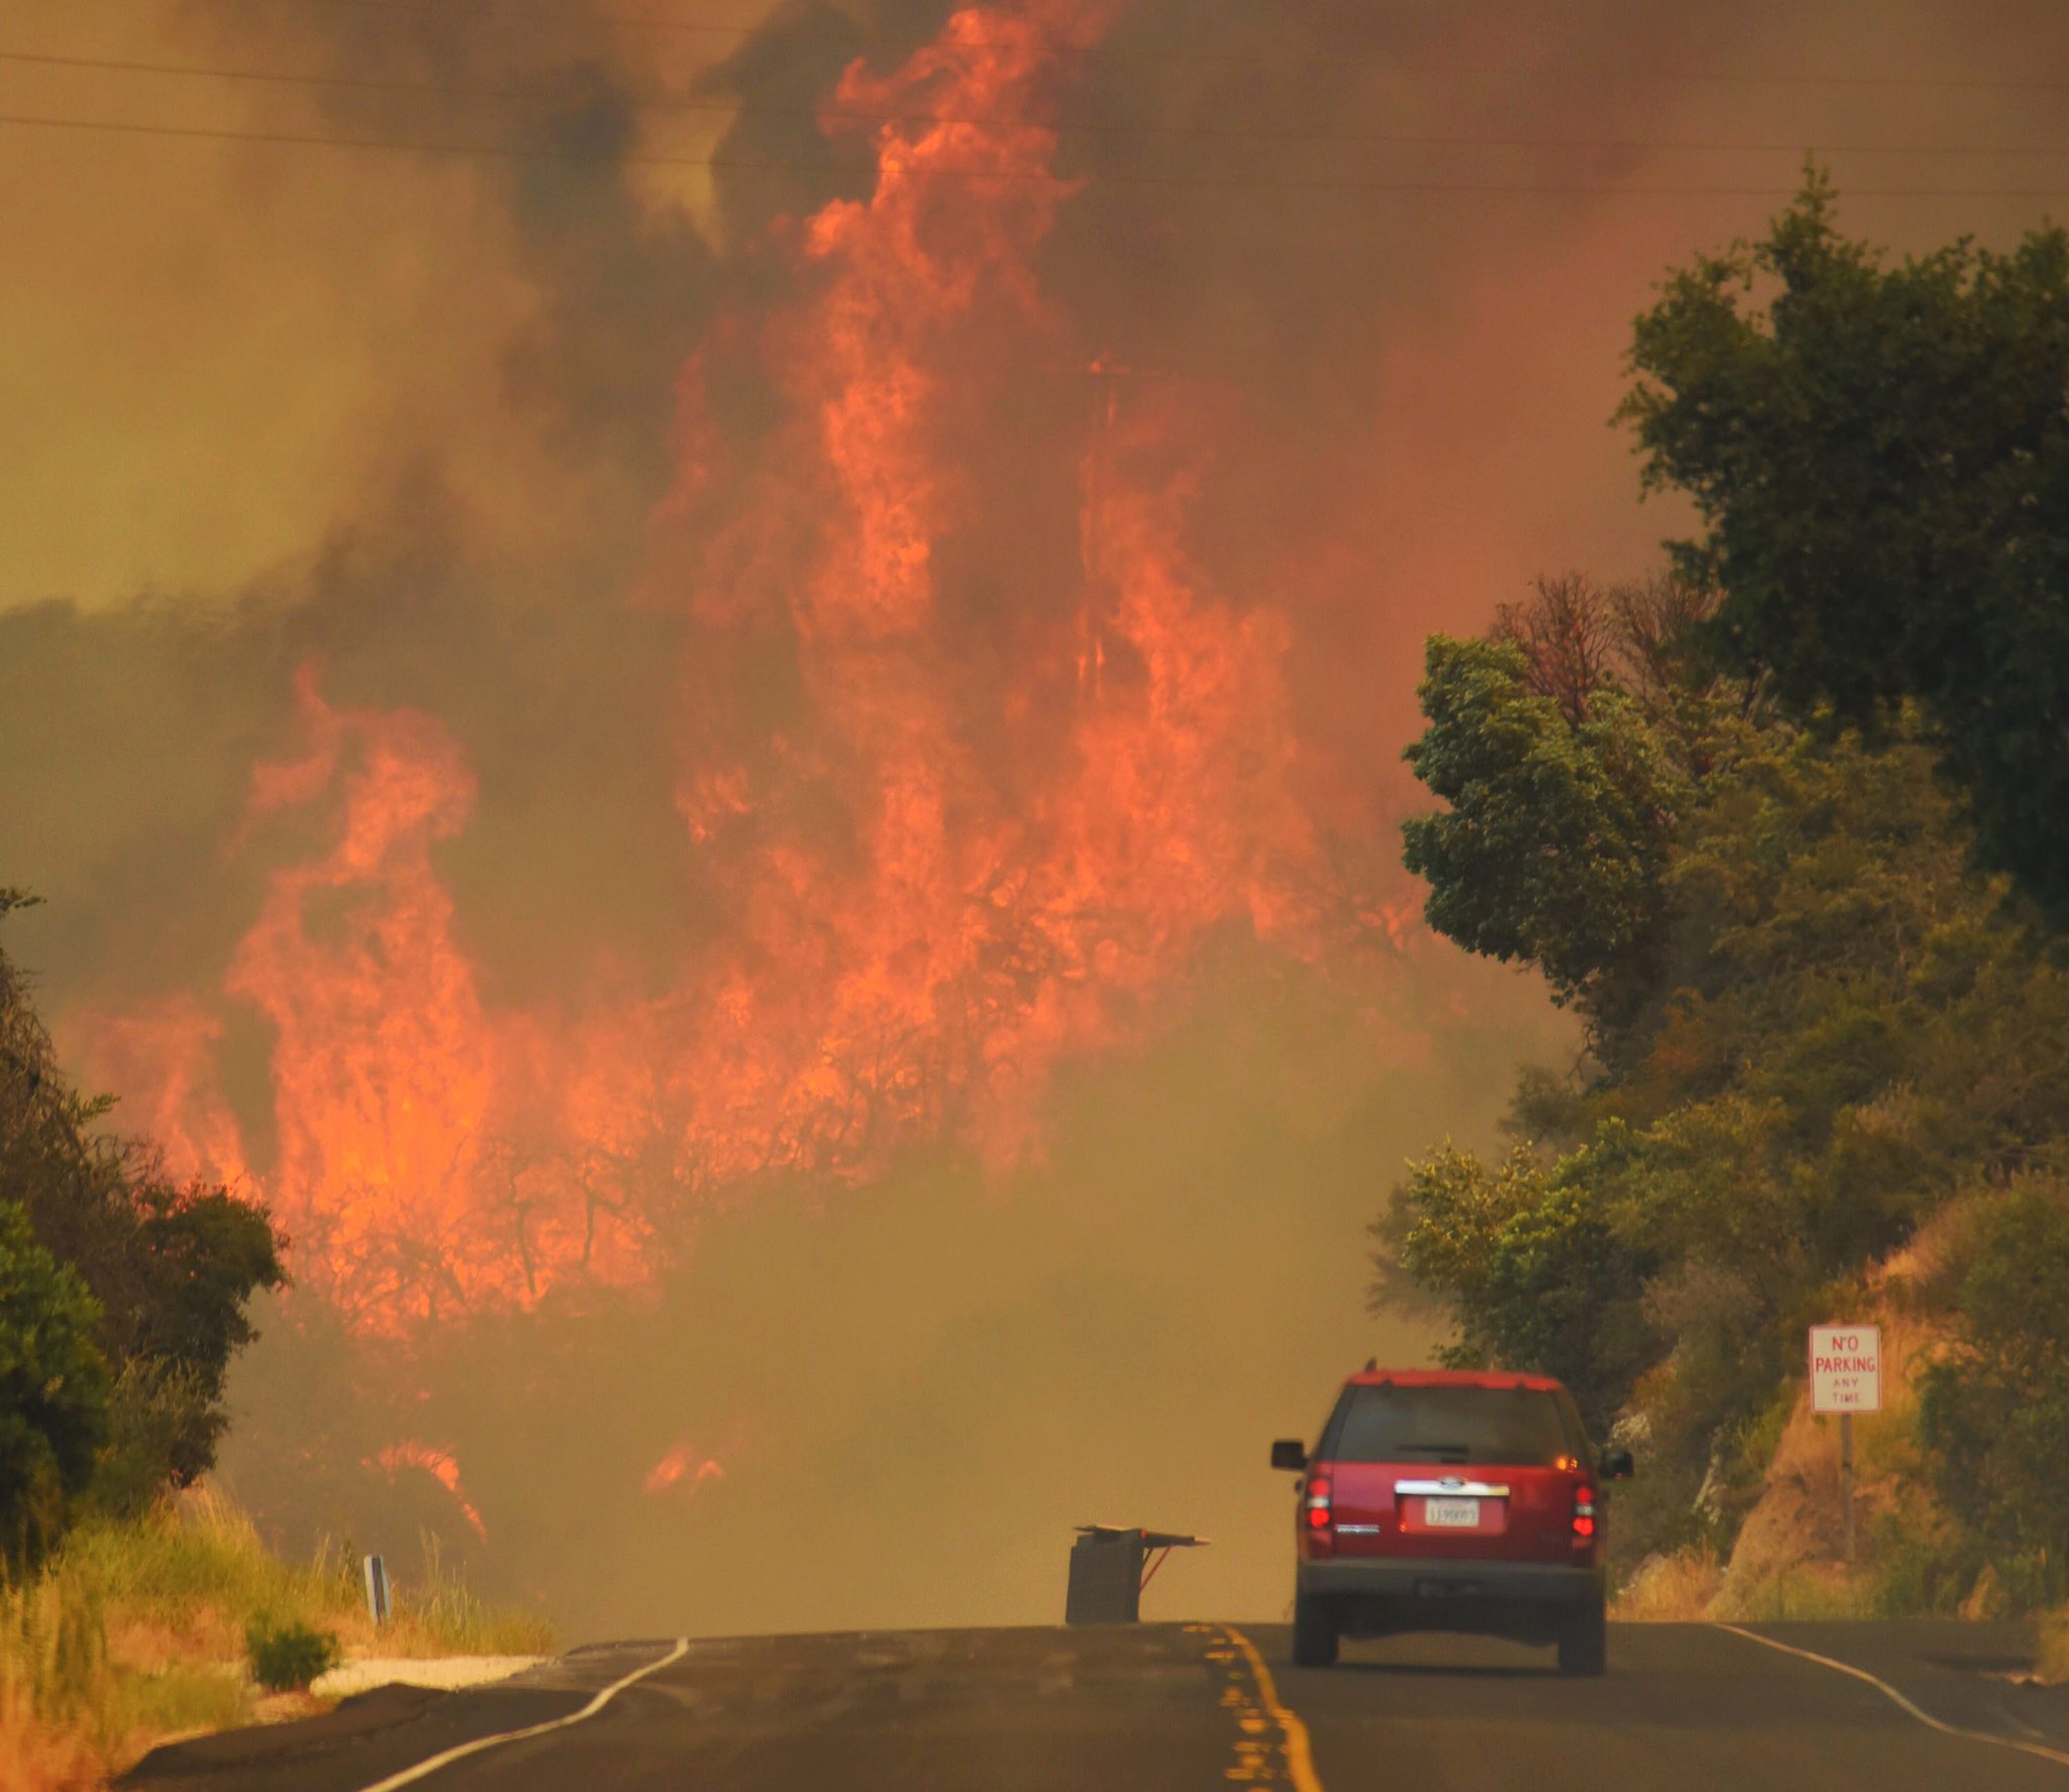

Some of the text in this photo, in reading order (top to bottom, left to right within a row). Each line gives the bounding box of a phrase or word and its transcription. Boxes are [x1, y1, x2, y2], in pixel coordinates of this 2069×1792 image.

[1832, 1336, 1859, 1351] NO
[1816, 1356, 1875, 1373] PARKING
[1833, 1378, 1859, 1387] ANY
[1833, 1393, 1859, 1403] TIME
